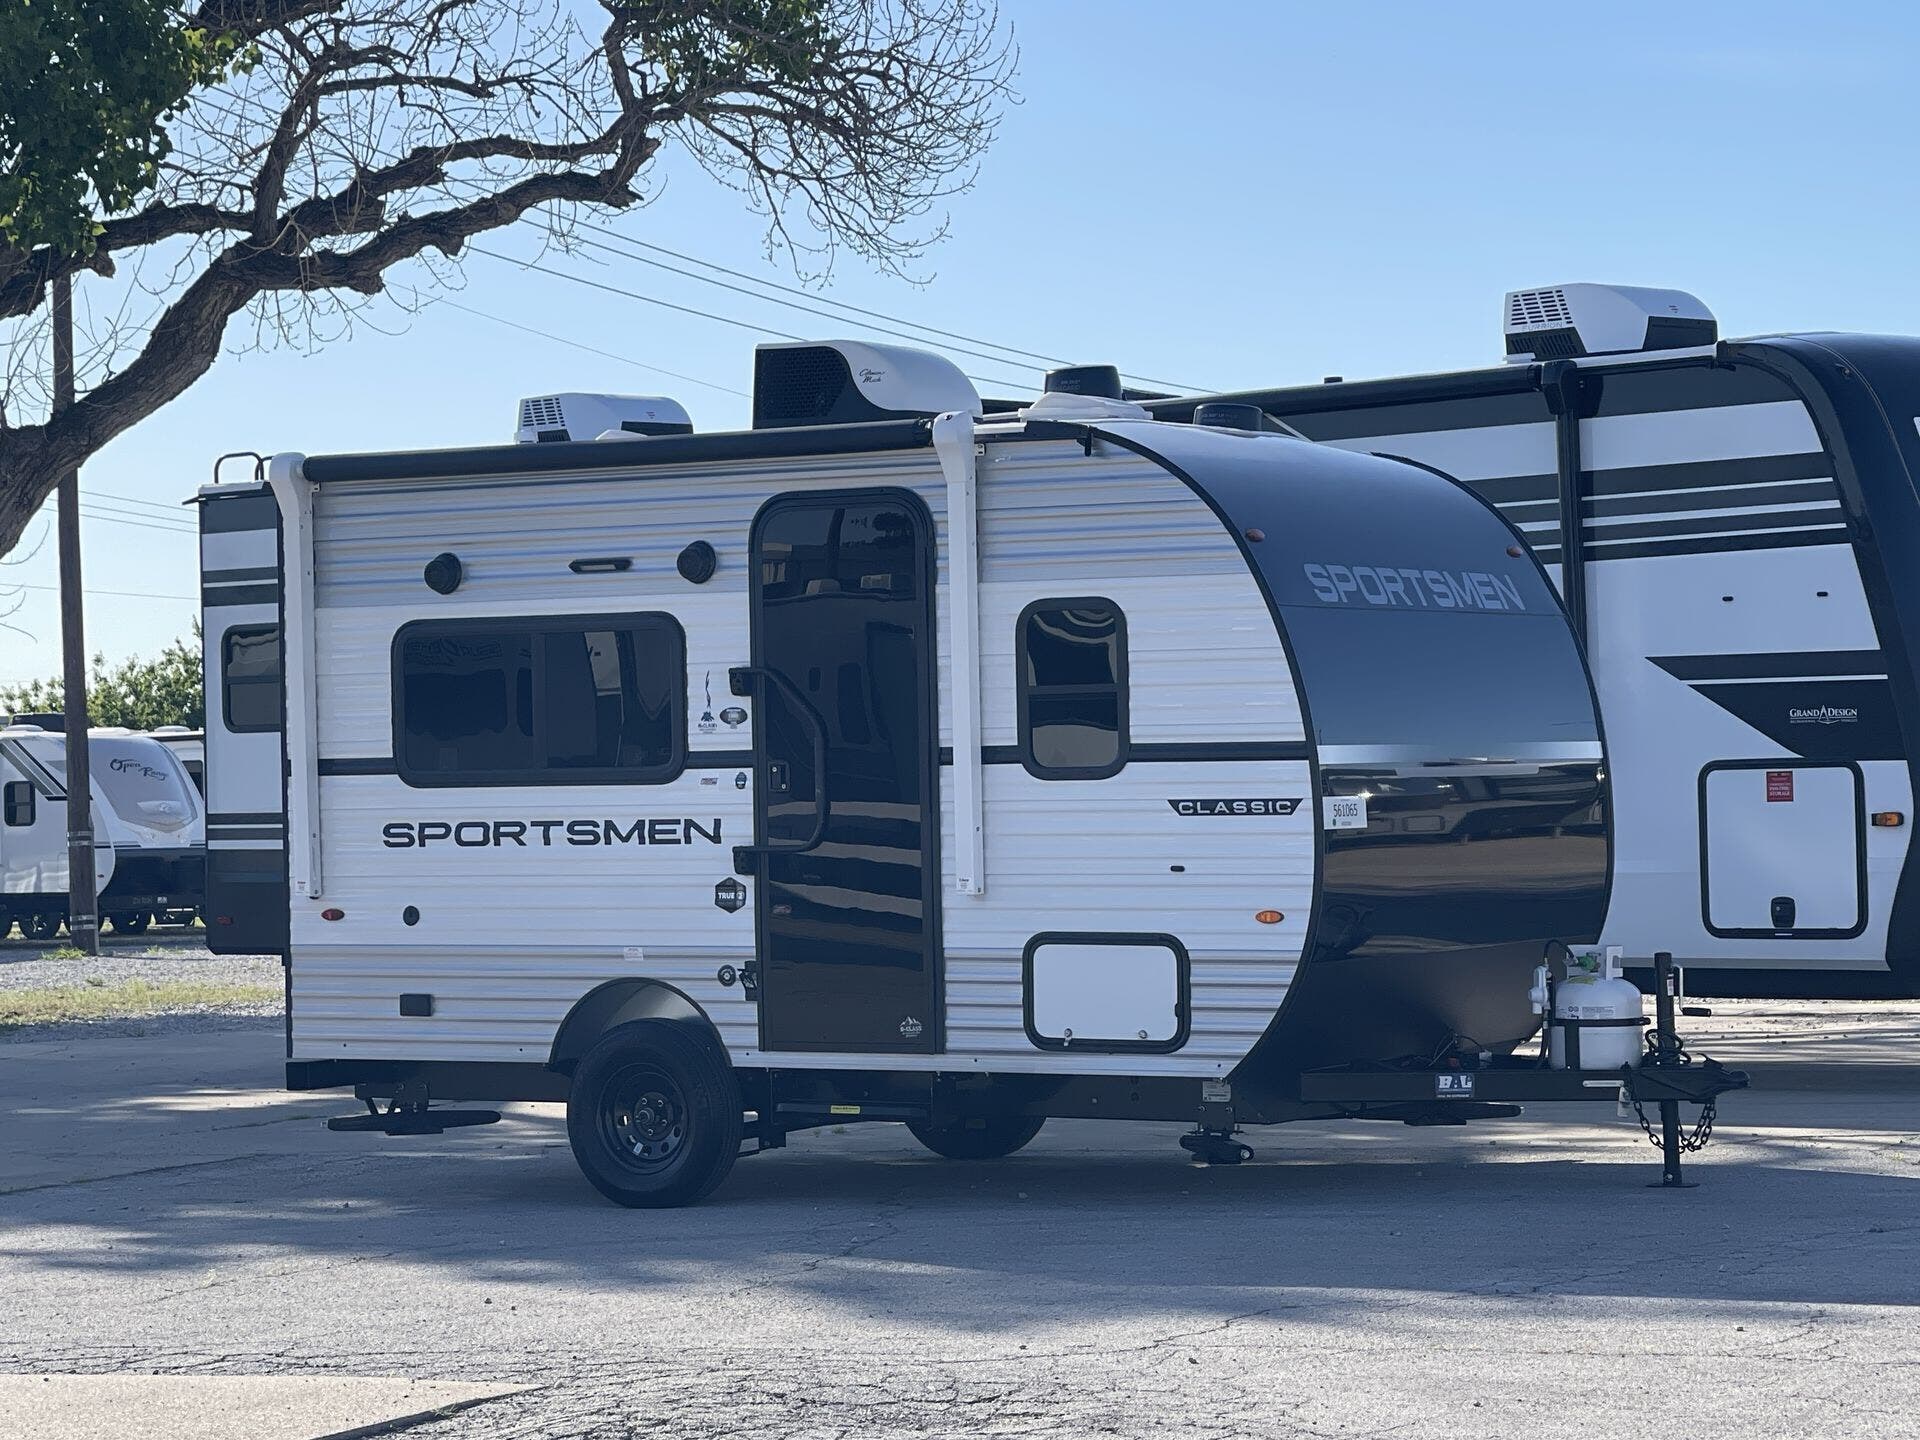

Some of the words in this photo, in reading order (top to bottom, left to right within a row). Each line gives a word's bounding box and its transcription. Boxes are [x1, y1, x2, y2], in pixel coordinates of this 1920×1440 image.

[1304, 563, 1526, 611] SPORTSMEN
[1789, 708, 1820, 717] GRAND
[1827, 707, 1858, 717] DESIGN
[1178, 800, 1292, 815] CLASSIC
[1333, 803, 1358, 817] 561065
[382, 818, 723, 848] SPORTSMEN
